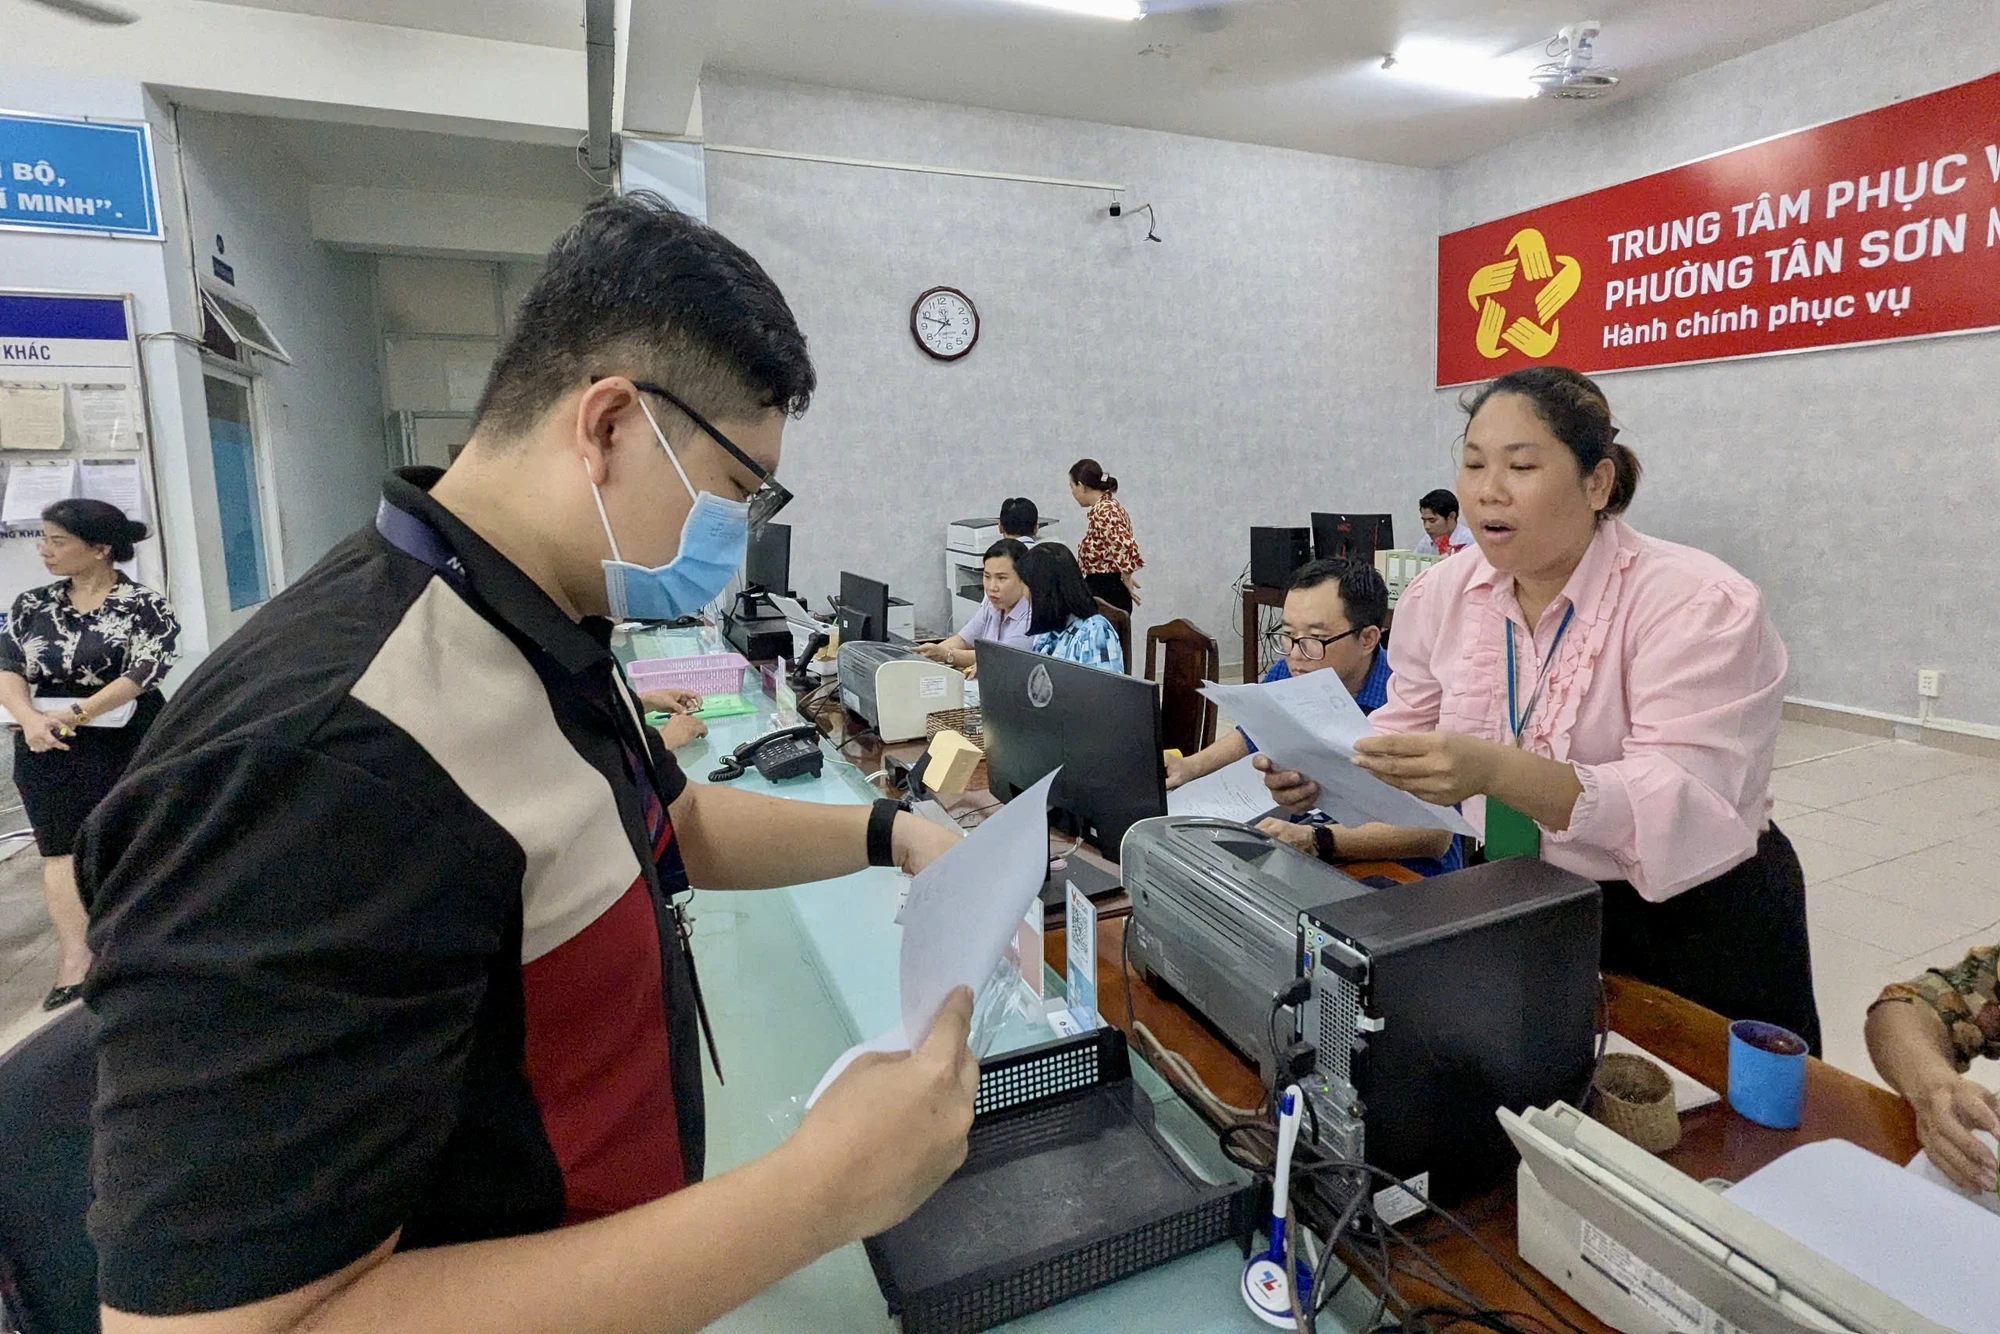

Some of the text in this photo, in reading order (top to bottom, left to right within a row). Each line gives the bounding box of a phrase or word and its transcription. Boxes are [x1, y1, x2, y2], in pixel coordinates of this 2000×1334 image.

[12, 159, 66, 188] BỘ,
[1607, 211, 1721, 265] TRUNG
[1732, 188, 1811, 237] TÂM
[1826, 153, 1968, 220] PHỤC
[1605, 256, 1754, 311] PHƯỜNG
[1765, 237, 1844, 284] TÂN
[1858, 213, 1968, 269] SƠN
[928, 302, 936, 310] 11
[937, 297, 947, 305] 12
[1602, 286, 1912, 348] Hành chính phục vụ
[921, 322, 928, 330] 9
[935, 340, 942, 349] 7
[956, 337, 963, 345] 5
[3, 341, 51, 360] KHÁC
